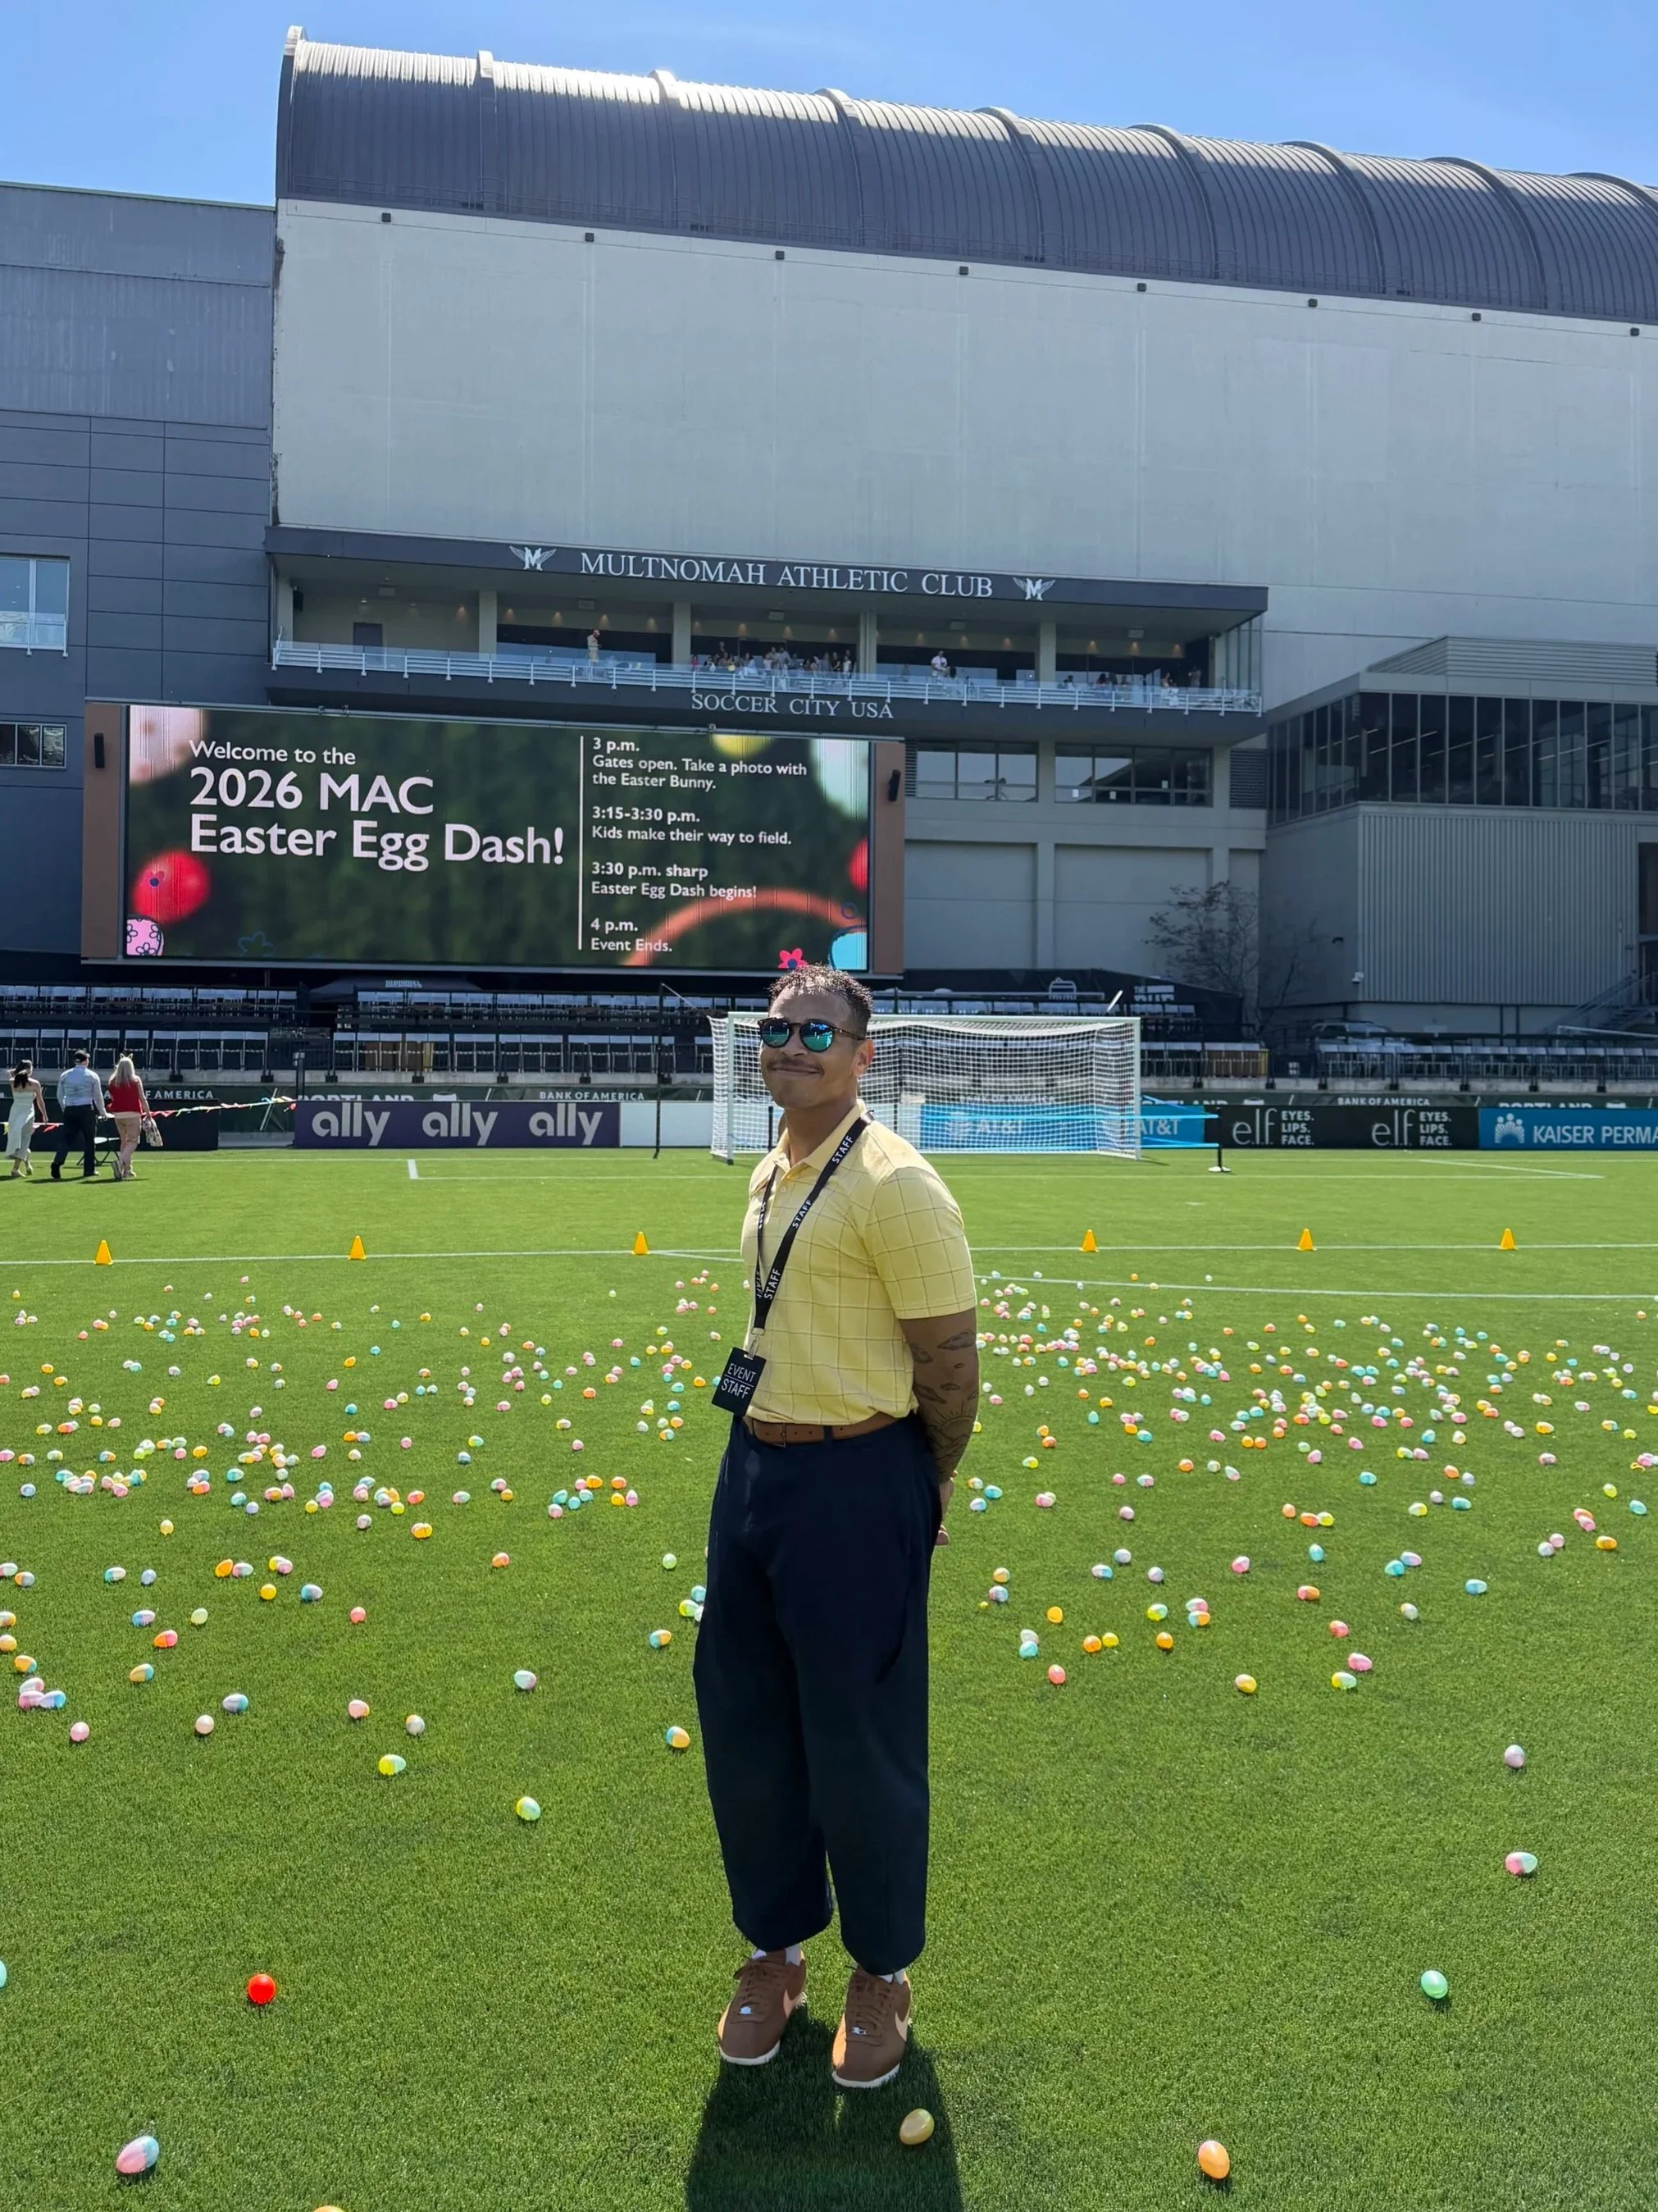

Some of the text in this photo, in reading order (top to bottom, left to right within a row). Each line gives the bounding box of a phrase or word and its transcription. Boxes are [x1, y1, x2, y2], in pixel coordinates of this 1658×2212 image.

[581, 552, 993, 598] MULTNOMAH ATHLETIC CLUB
[691, 694, 894, 718] SOCCER CITY USA
[189, 740, 356, 764] Welcome to the
[593, 737, 640, 753] 3 p.m.
[593, 755, 808, 776] Gates open. Take a photo with
[189, 766, 434, 814] 2026 MAC
[592, 773, 717, 791] the Easter Bunny.
[592, 806, 700, 824] 3:15-3:30 p.m.
[191, 814, 563, 872] Easter Egg Dash!
[592, 826, 792, 846] Kids make their way to field.
[591, 861, 708, 880] 3:30 p.m. sharp
[591, 881, 757, 901] Easter Egg Dash begins!
[590, 918, 639, 934] 4 p.m.
[590, 937, 672, 952] Event Ends.
[154, 1090, 214, 1099] AMERICA
[540, 1091, 645, 1101] BANK OF AMERICA
[1337, 1097, 1430, 1106] BANK OF AMERICA
[312, 1102, 390, 1146] ally
[422, 1102, 499, 1146] ally
[529, 1102, 604, 1146] ally
[1281, 1111, 1314, 1121] EYES.
[1419, 1111, 1452, 1122] EYES.
[1281, 1123, 1310, 1133] LIPS.
[1419, 1124, 1449, 1134] LIPS.
[1533, 1125, 1595, 1143] KAISER
[1281, 1134, 1315, 1145] FACE.
[1419, 1135, 1453, 1146] FACE.
[831, 1135, 854, 1164] STAFF
[792, 1199, 813, 1229] STAFF
[763, 1268, 781, 1300] STAFF
[727, 1362, 757, 1383] EVENT
[722, 1378, 750, 1398] STAFF
